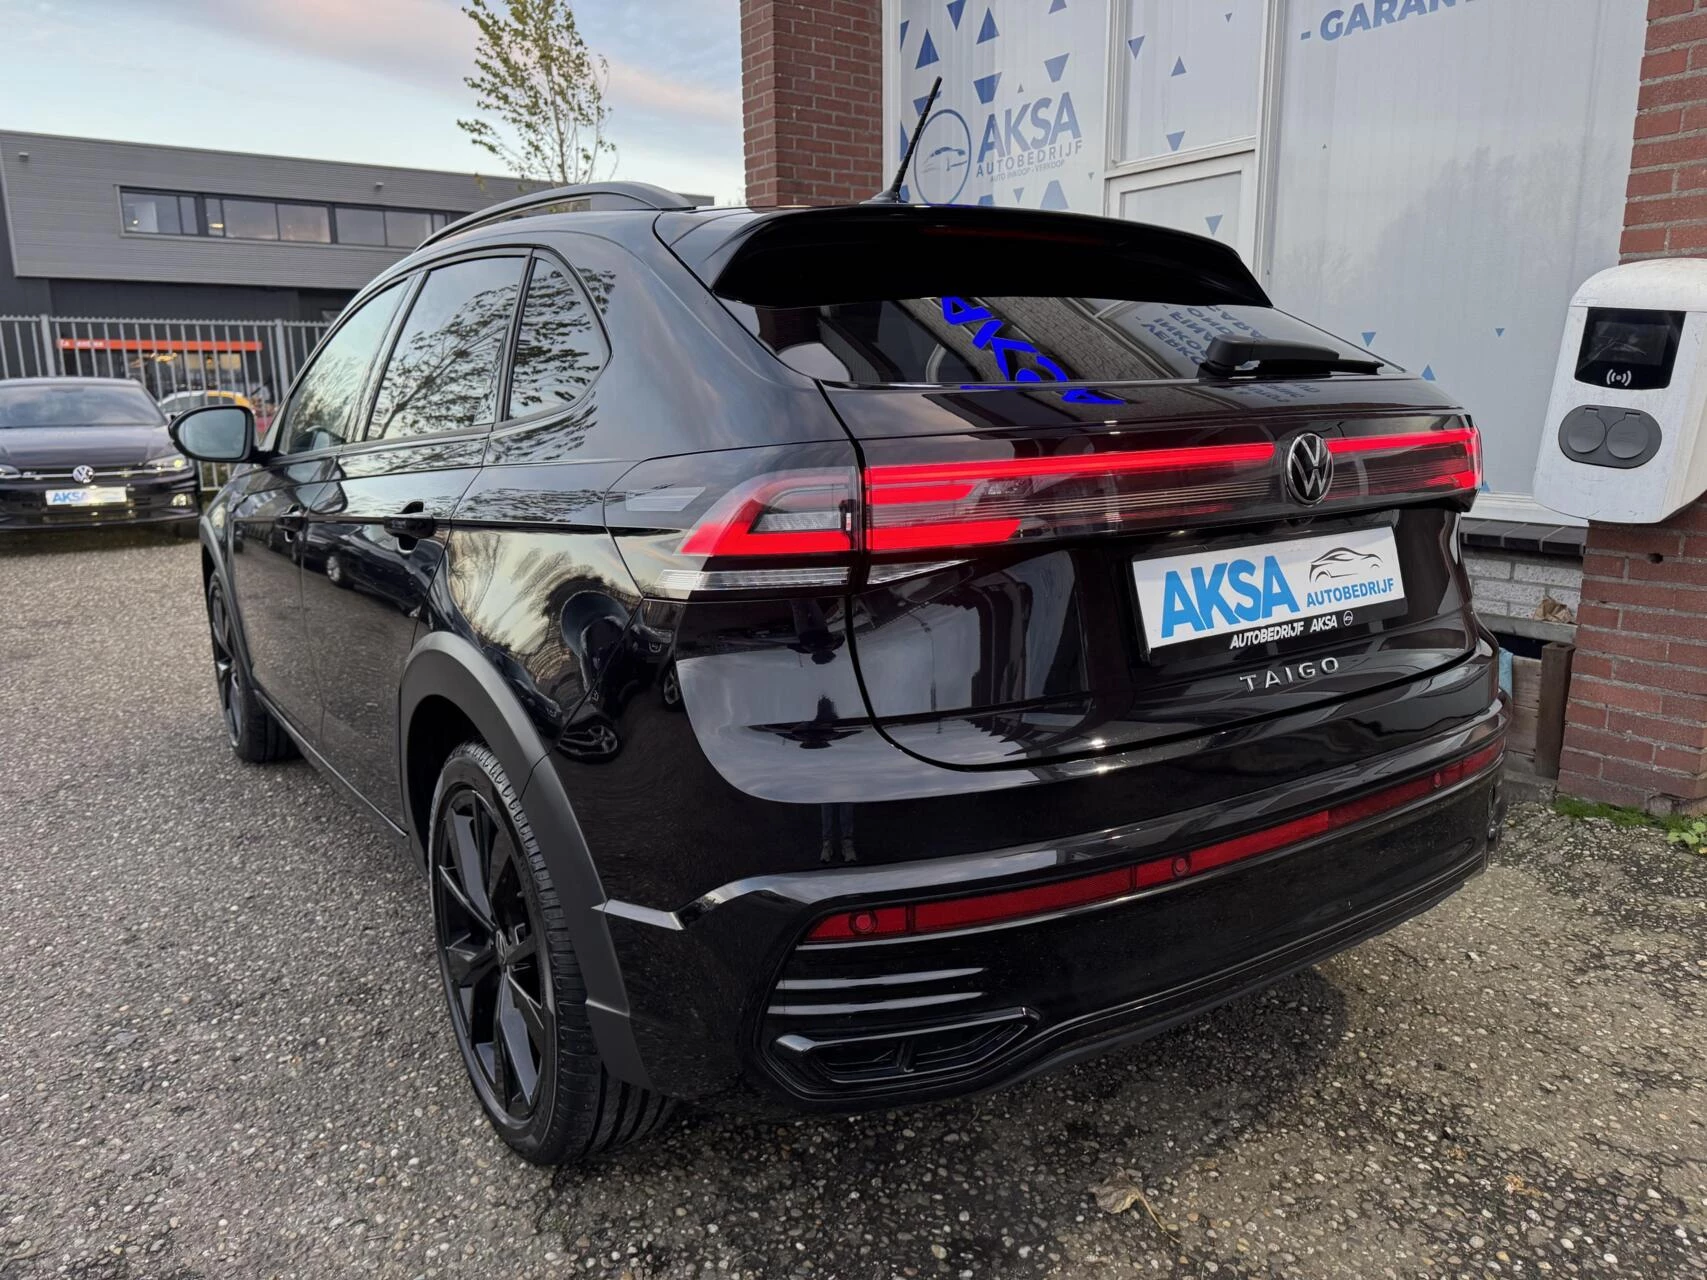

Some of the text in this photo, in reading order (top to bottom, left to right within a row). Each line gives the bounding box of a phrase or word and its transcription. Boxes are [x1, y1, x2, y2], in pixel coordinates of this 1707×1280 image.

[1319, 0, 1474, 41] GARA
[976, 91, 1083, 164] AKSA
[976, 139, 1083, 178] AUTOBEDRIJF
[1161, 555, 1301, 639] AKSA
[1306, 577, 1395, 608] AUTOBEDRIJF
[1229, 614, 1338, 650] AUTOBEDRIJF AKSA
[1239, 656, 1340, 693] TAIGO
